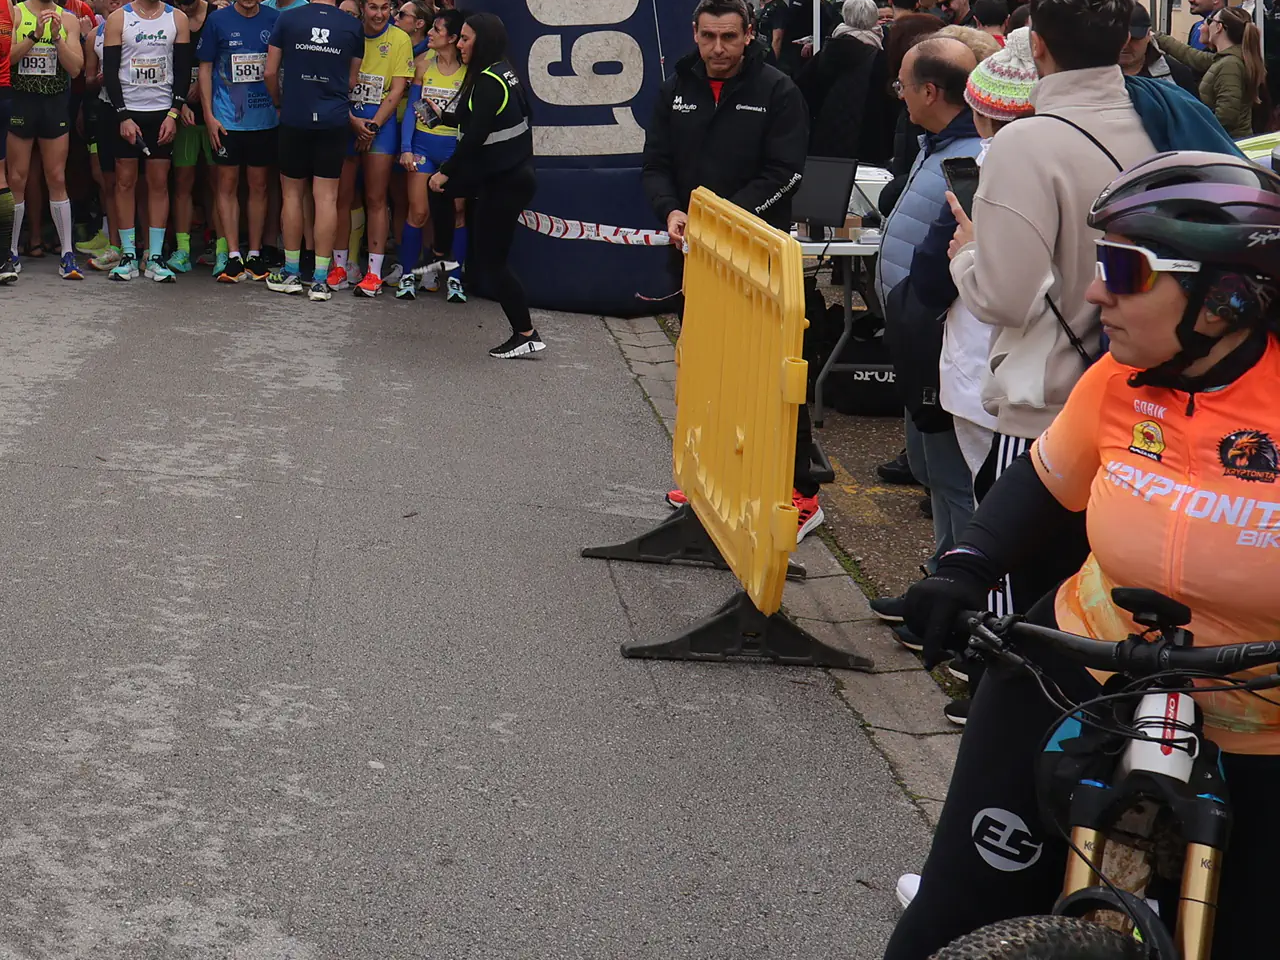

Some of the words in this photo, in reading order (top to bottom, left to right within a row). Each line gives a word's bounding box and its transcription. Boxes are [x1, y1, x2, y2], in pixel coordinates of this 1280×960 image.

[22, 56, 46, 69] 093
[135, 67, 156, 80] 140
[235, 64, 260, 77] 584
[348, 83, 371, 98] 34
[1133, 399, 1168, 420] GOBIK
[1224, 468, 1276, 479] KRYPTONITA
